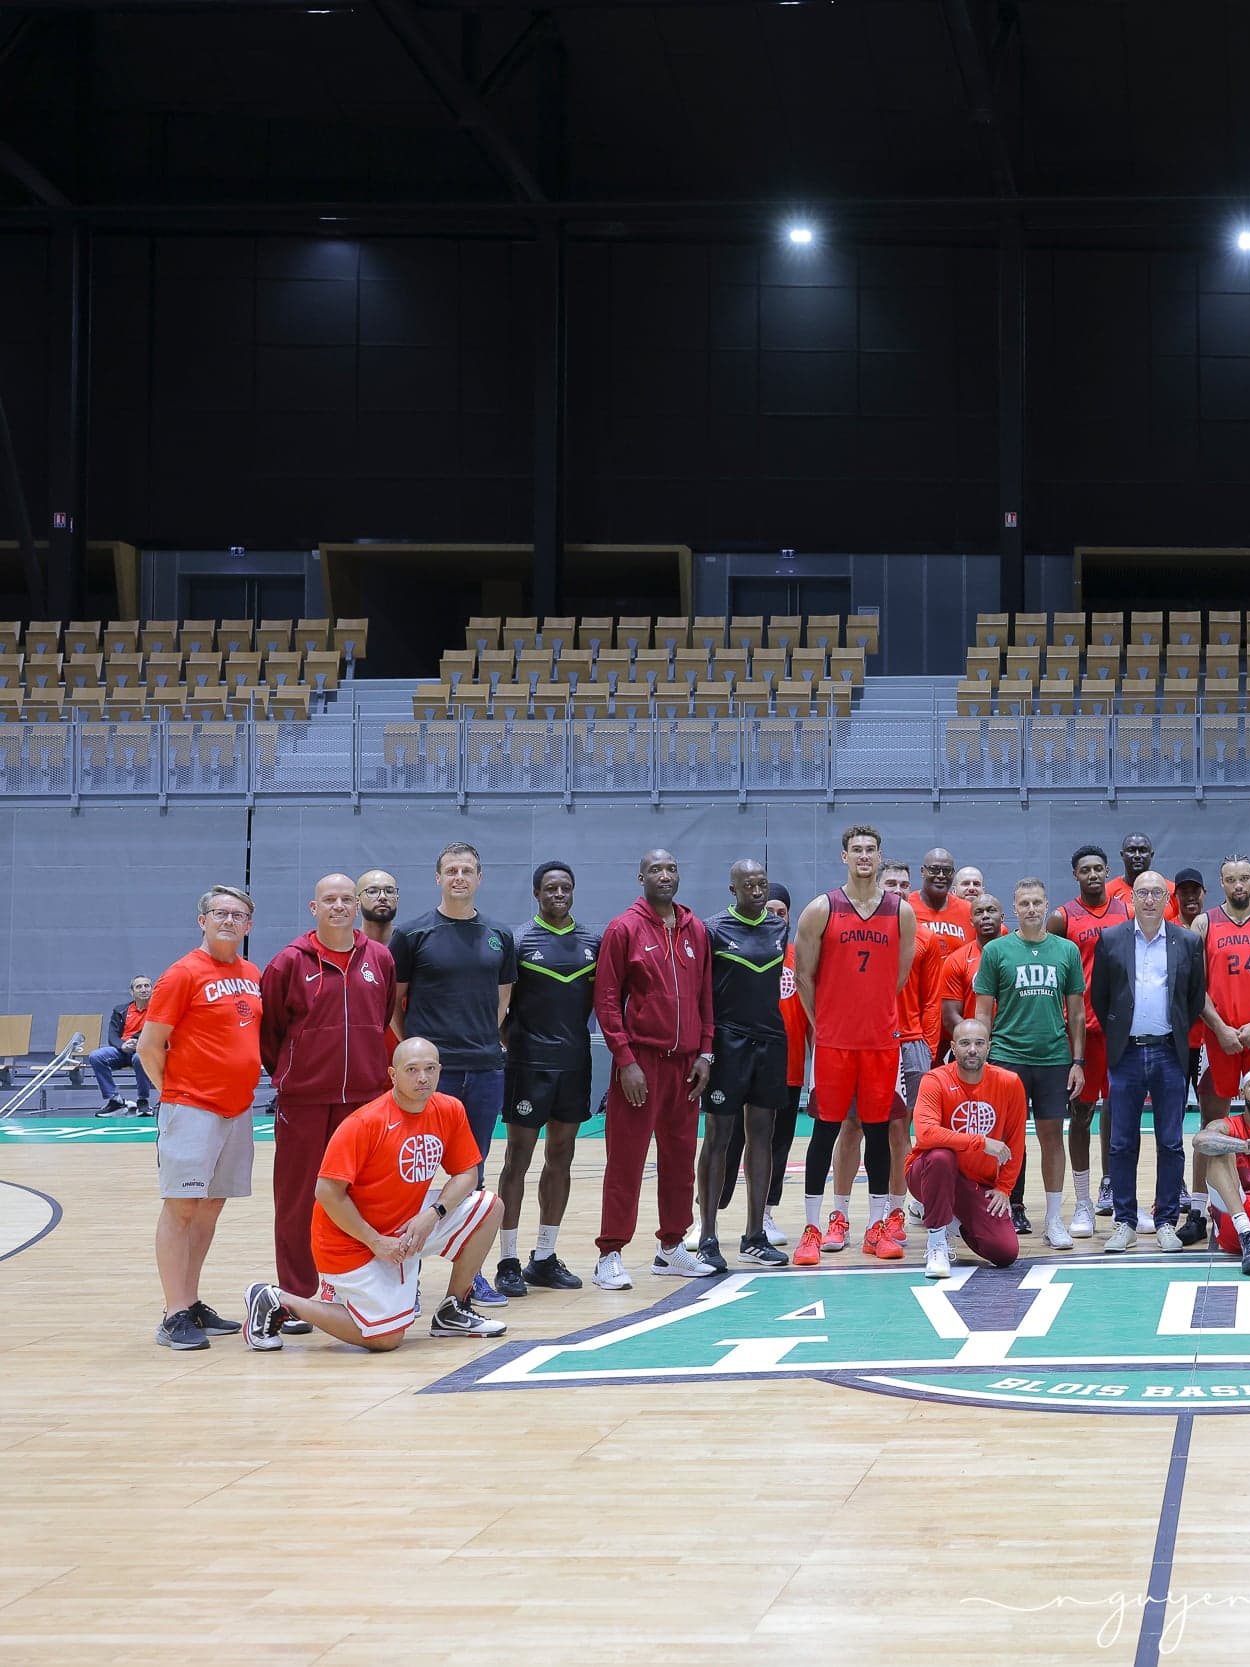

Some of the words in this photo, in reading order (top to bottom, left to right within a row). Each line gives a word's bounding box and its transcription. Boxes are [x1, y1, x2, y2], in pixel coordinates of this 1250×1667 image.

[840, 929, 889, 946] CANADA
[922, 921, 966, 941] NADA
[857, 950, 870, 972] 7
[1014, 964, 1058, 989] ADA
[204, 979, 262, 1002] CANADA
[1019, 988, 1054, 997] BASKETBALL
[415, 1134, 427, 1182] CAN
[986, 1377, 1129, 1398] BLOIS
